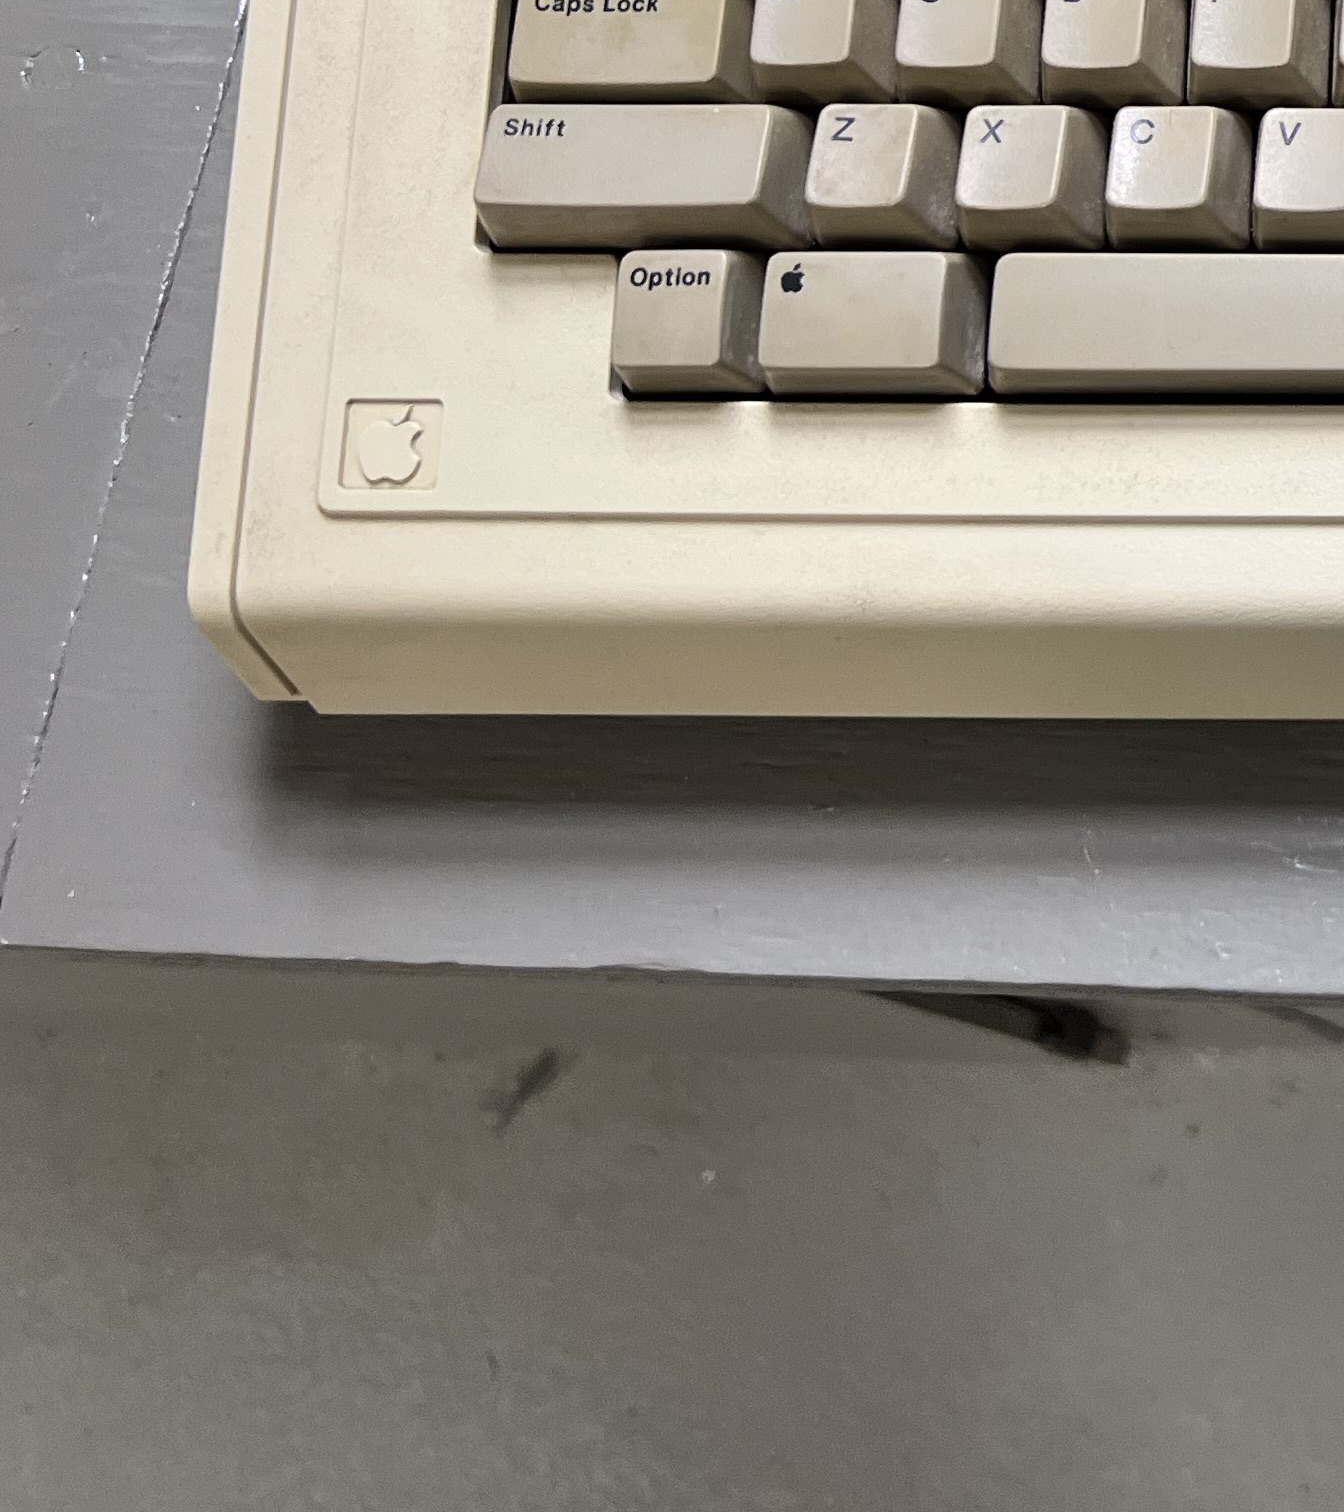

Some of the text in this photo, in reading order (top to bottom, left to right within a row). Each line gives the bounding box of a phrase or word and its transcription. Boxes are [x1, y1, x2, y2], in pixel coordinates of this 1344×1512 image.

[503, 118, 566, 137] Shift
[831, 116, 856, 142] Z
[979, 118, 1005, 144] X
[1131, 118, 1155, 145] C
[1279, 121, 1302, 146] V
[630, 267, 711, 291] Option
